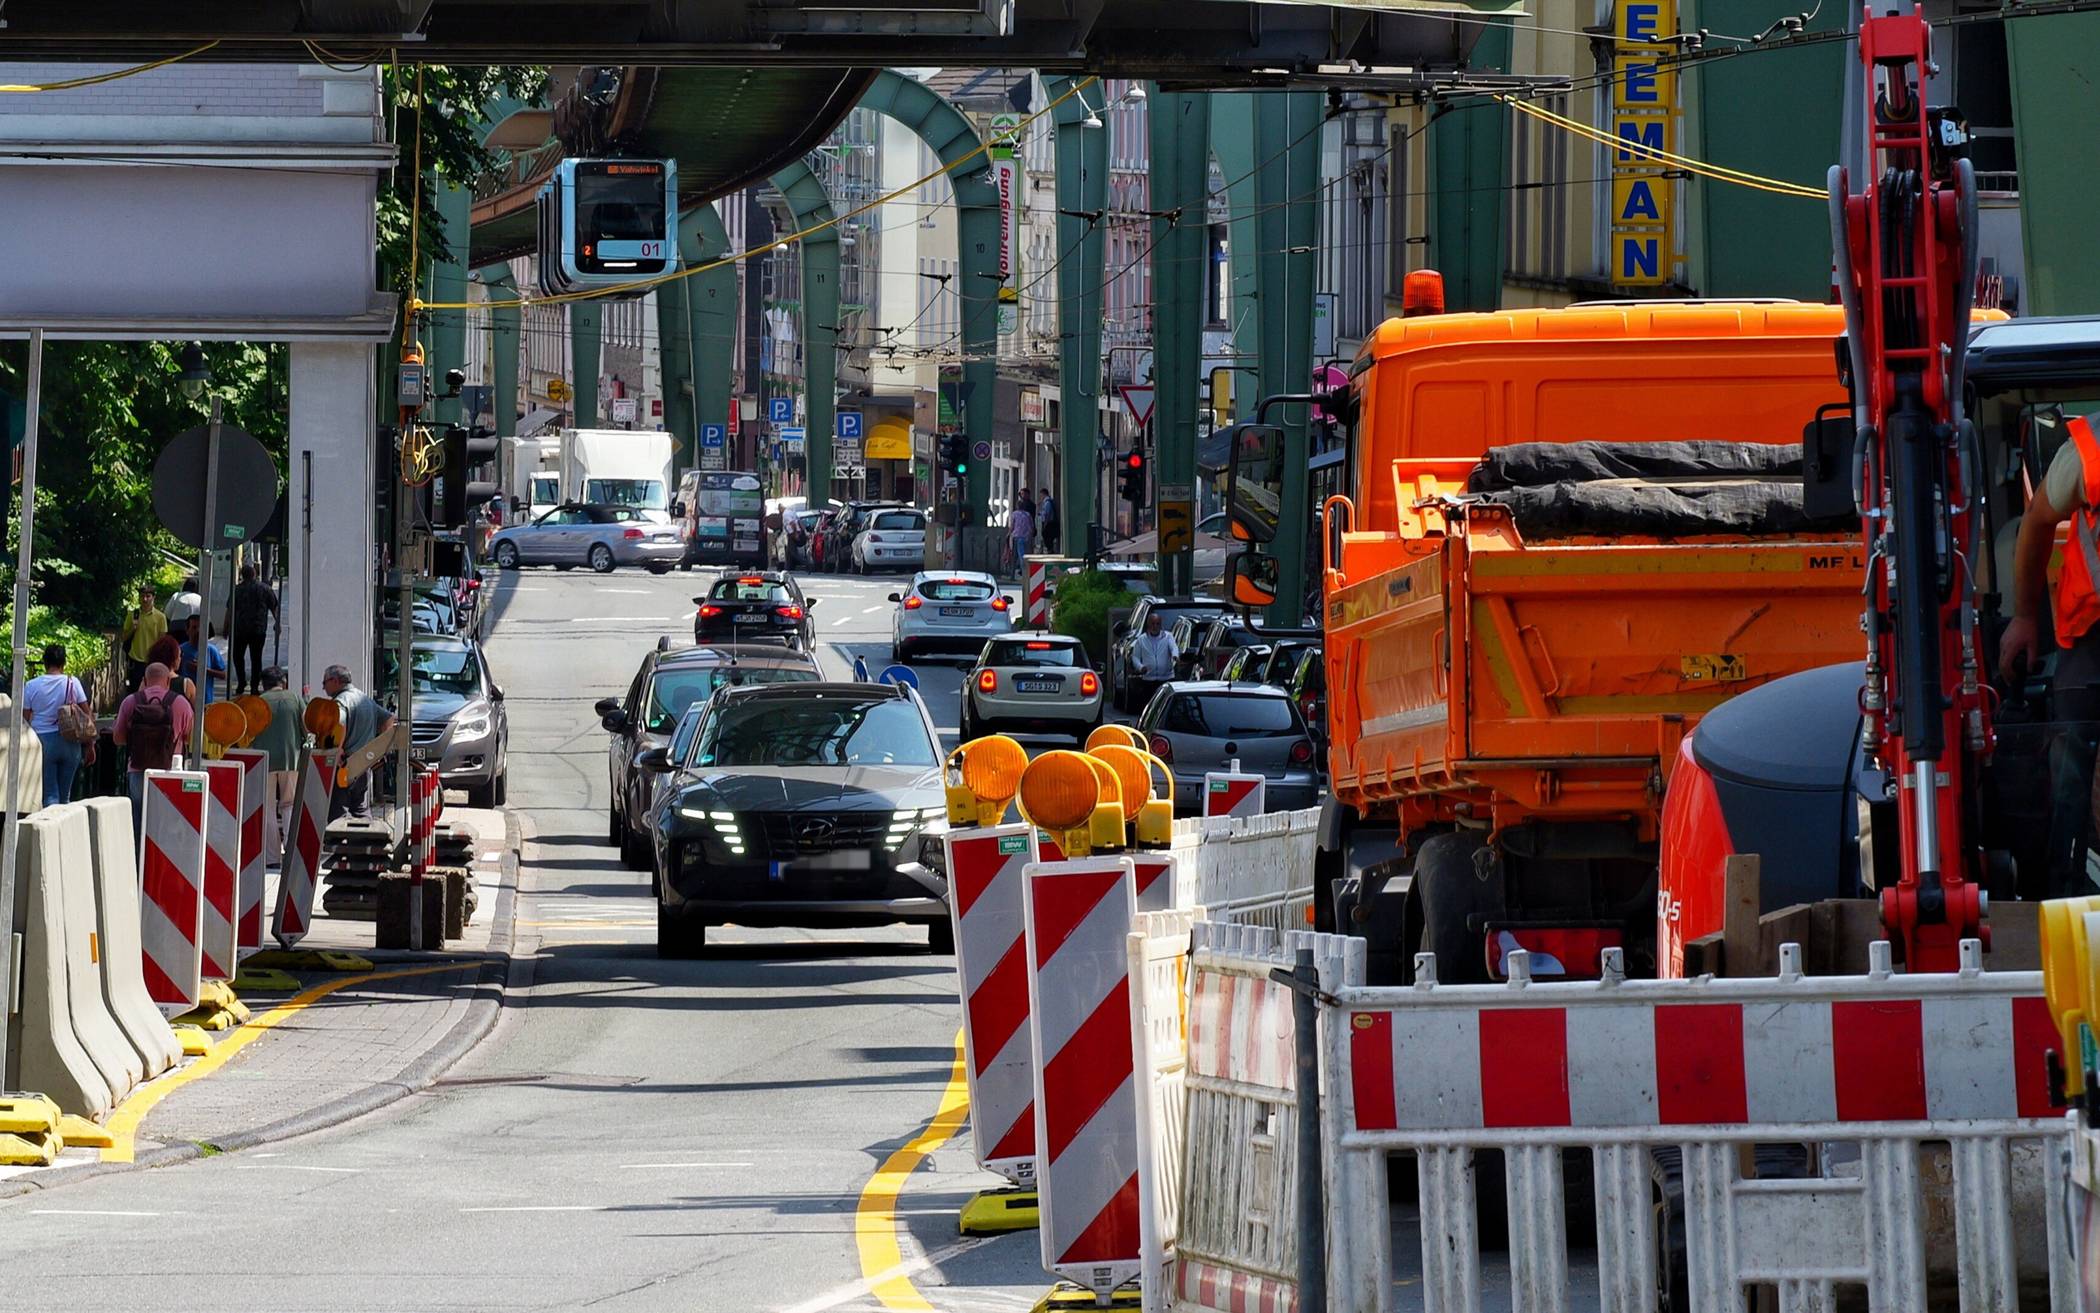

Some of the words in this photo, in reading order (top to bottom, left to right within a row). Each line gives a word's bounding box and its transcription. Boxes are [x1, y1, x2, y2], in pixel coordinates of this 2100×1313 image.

[1184, 101, 1192, 115] 7
[584, 245, 592, 256] 2
[641, 243, 660, 257] 01
[976, 243, 985, 254] 10
[842, 416, 856, 435] P
